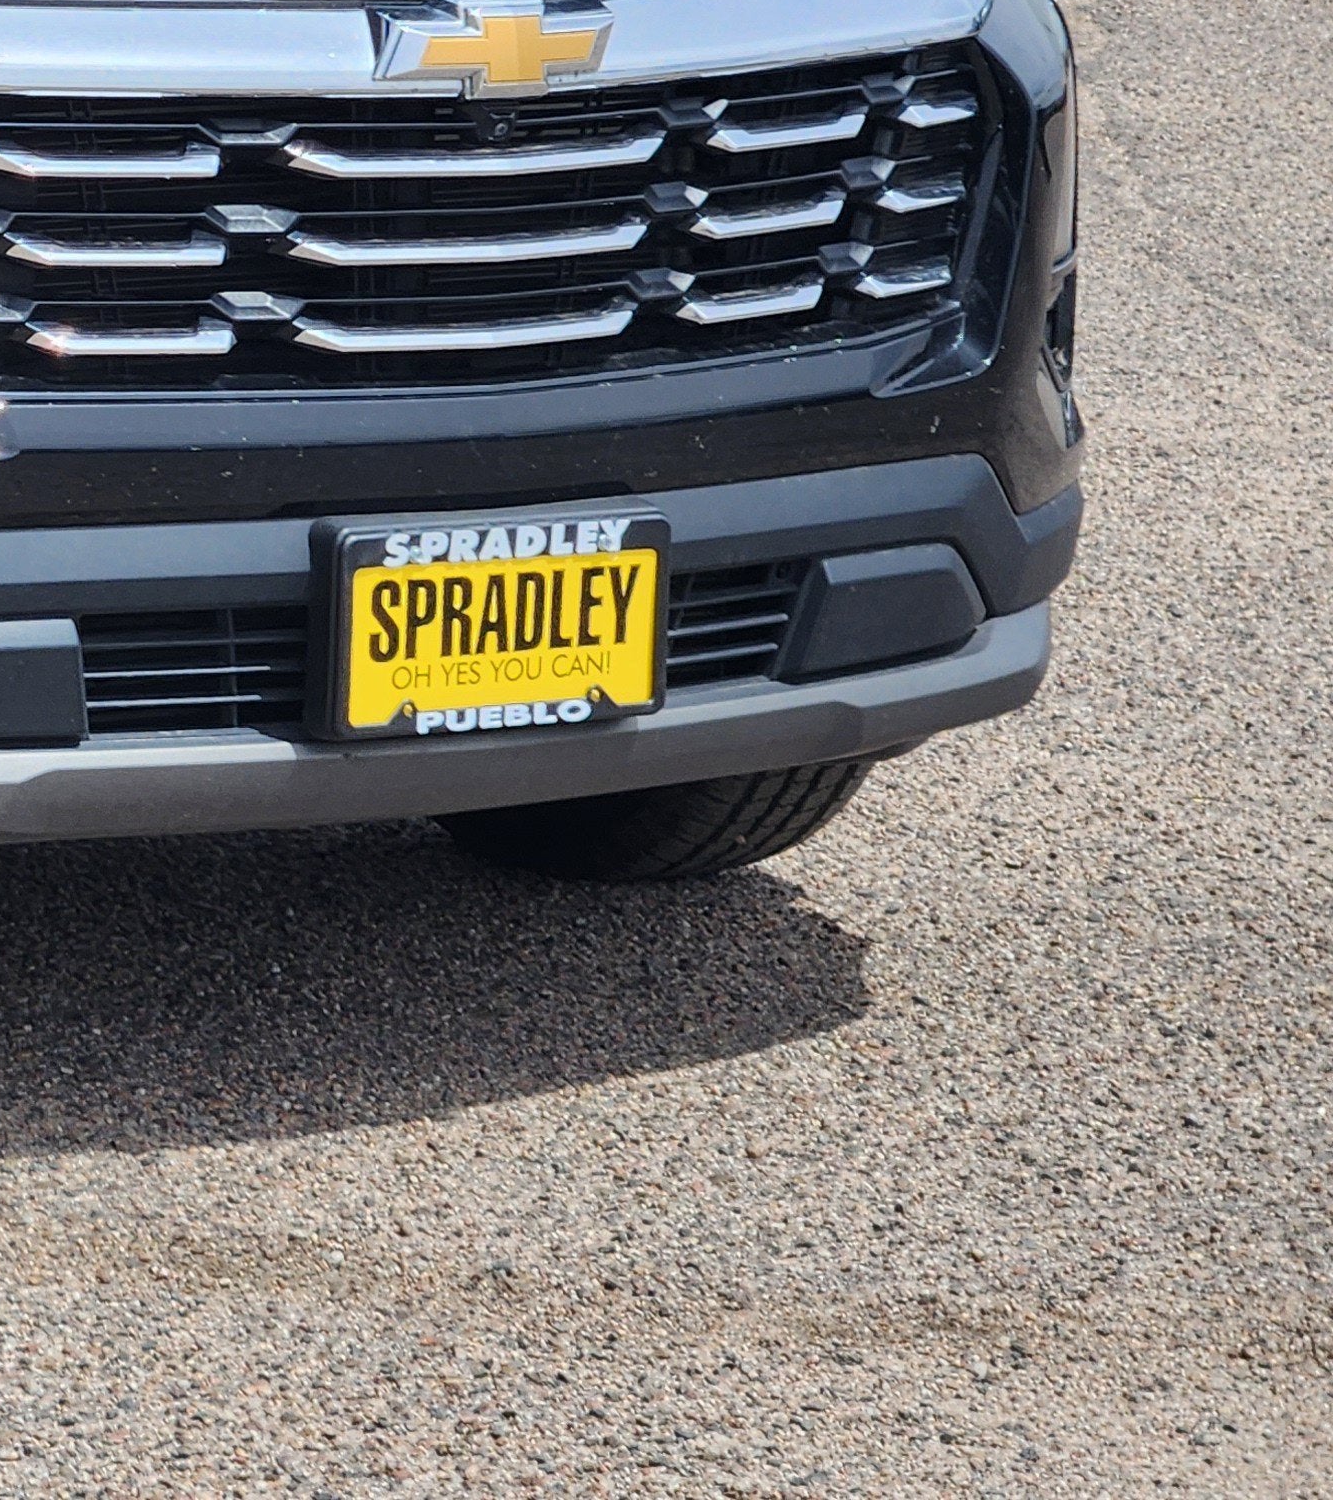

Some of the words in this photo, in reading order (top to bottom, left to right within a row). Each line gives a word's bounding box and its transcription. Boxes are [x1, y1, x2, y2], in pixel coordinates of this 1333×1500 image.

[383, 518, 631, 568] SPRADLEY
[369, 564, 641, 663] SPRADLEY
[391, 665, 432, 690] OH
[441, 661, 481, 686] YES
[490, 656, 543, 682] YOU
[552, 651, 611, 679] CAN!
[416, 699, 592, 735] PUEBLO
